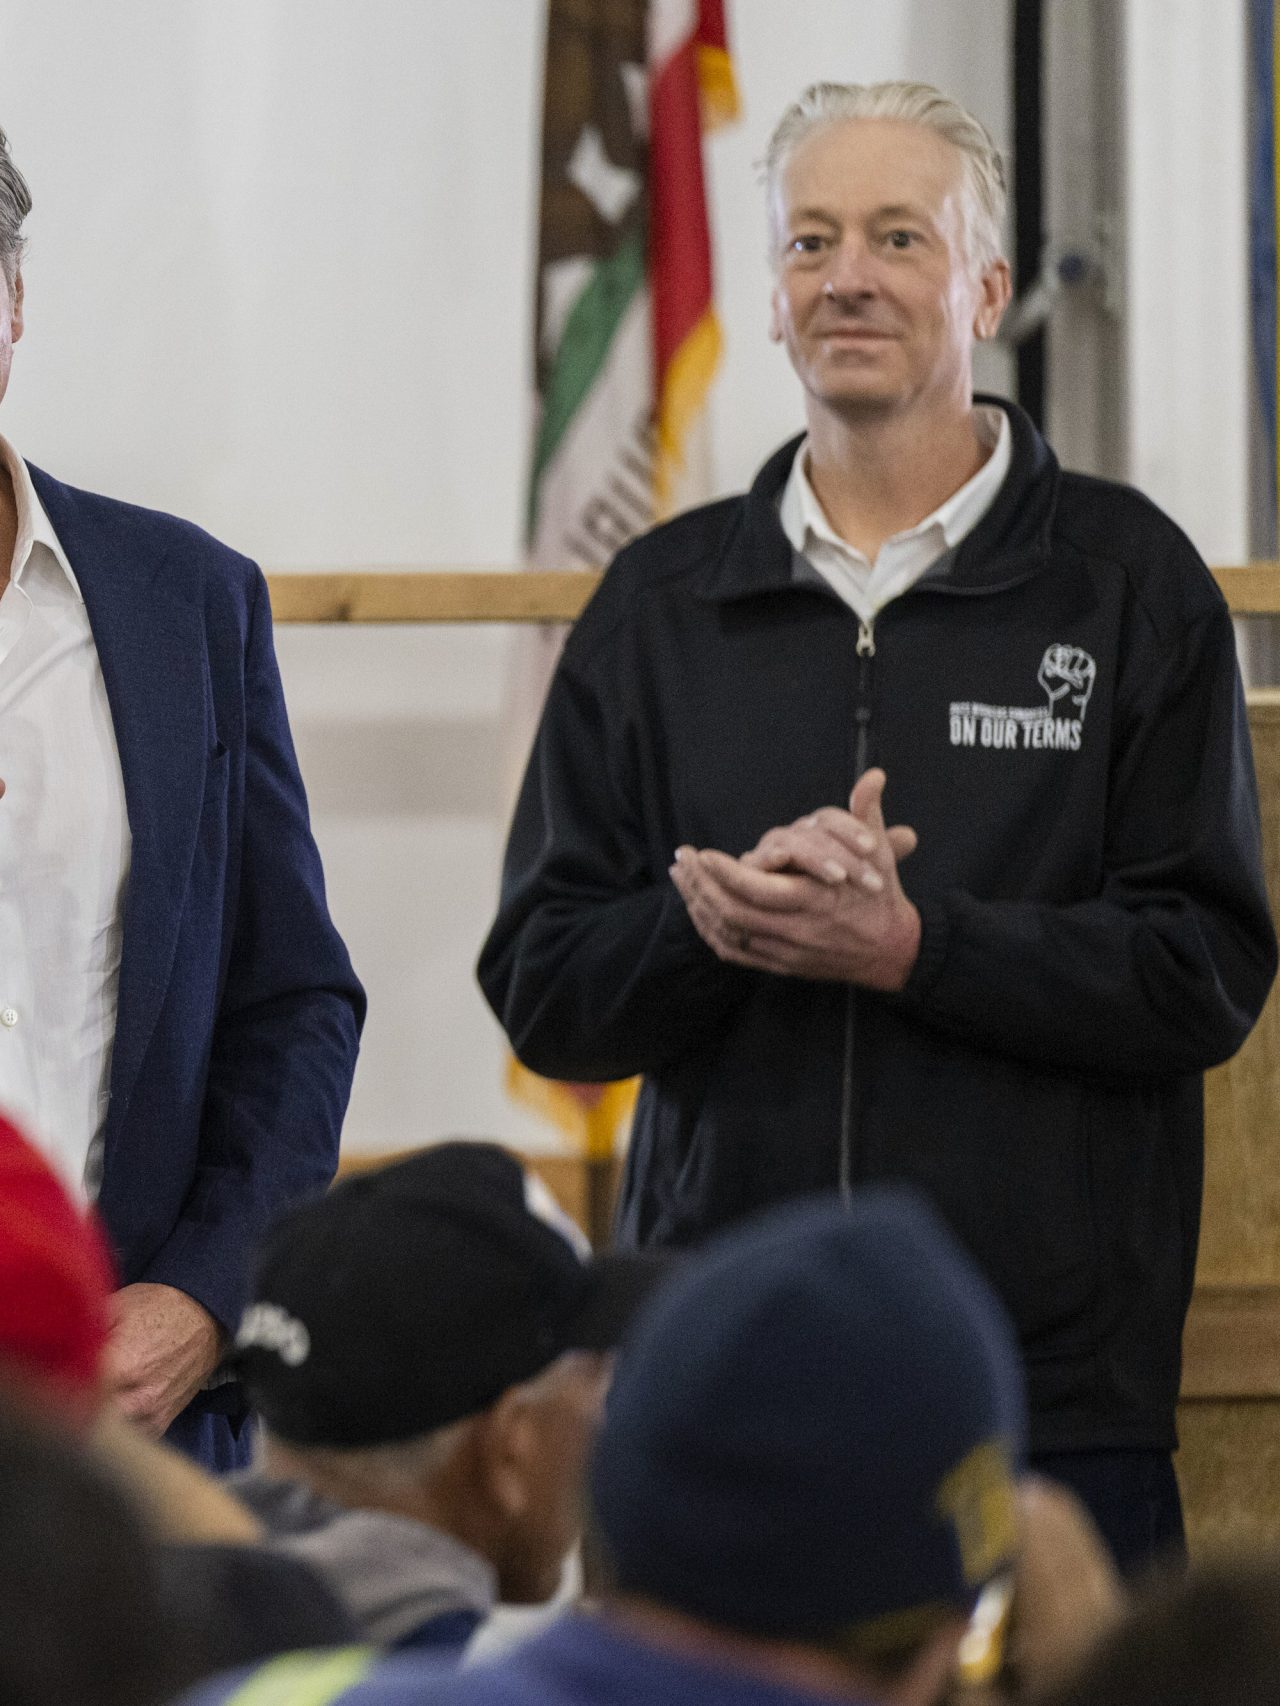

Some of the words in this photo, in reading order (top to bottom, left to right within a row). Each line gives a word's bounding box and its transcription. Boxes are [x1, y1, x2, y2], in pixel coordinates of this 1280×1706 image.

[950, 715, 976, 747] ON
[981, 717, 1018, 750] OUR
[1022, 717, 1082, 751] TERMS
